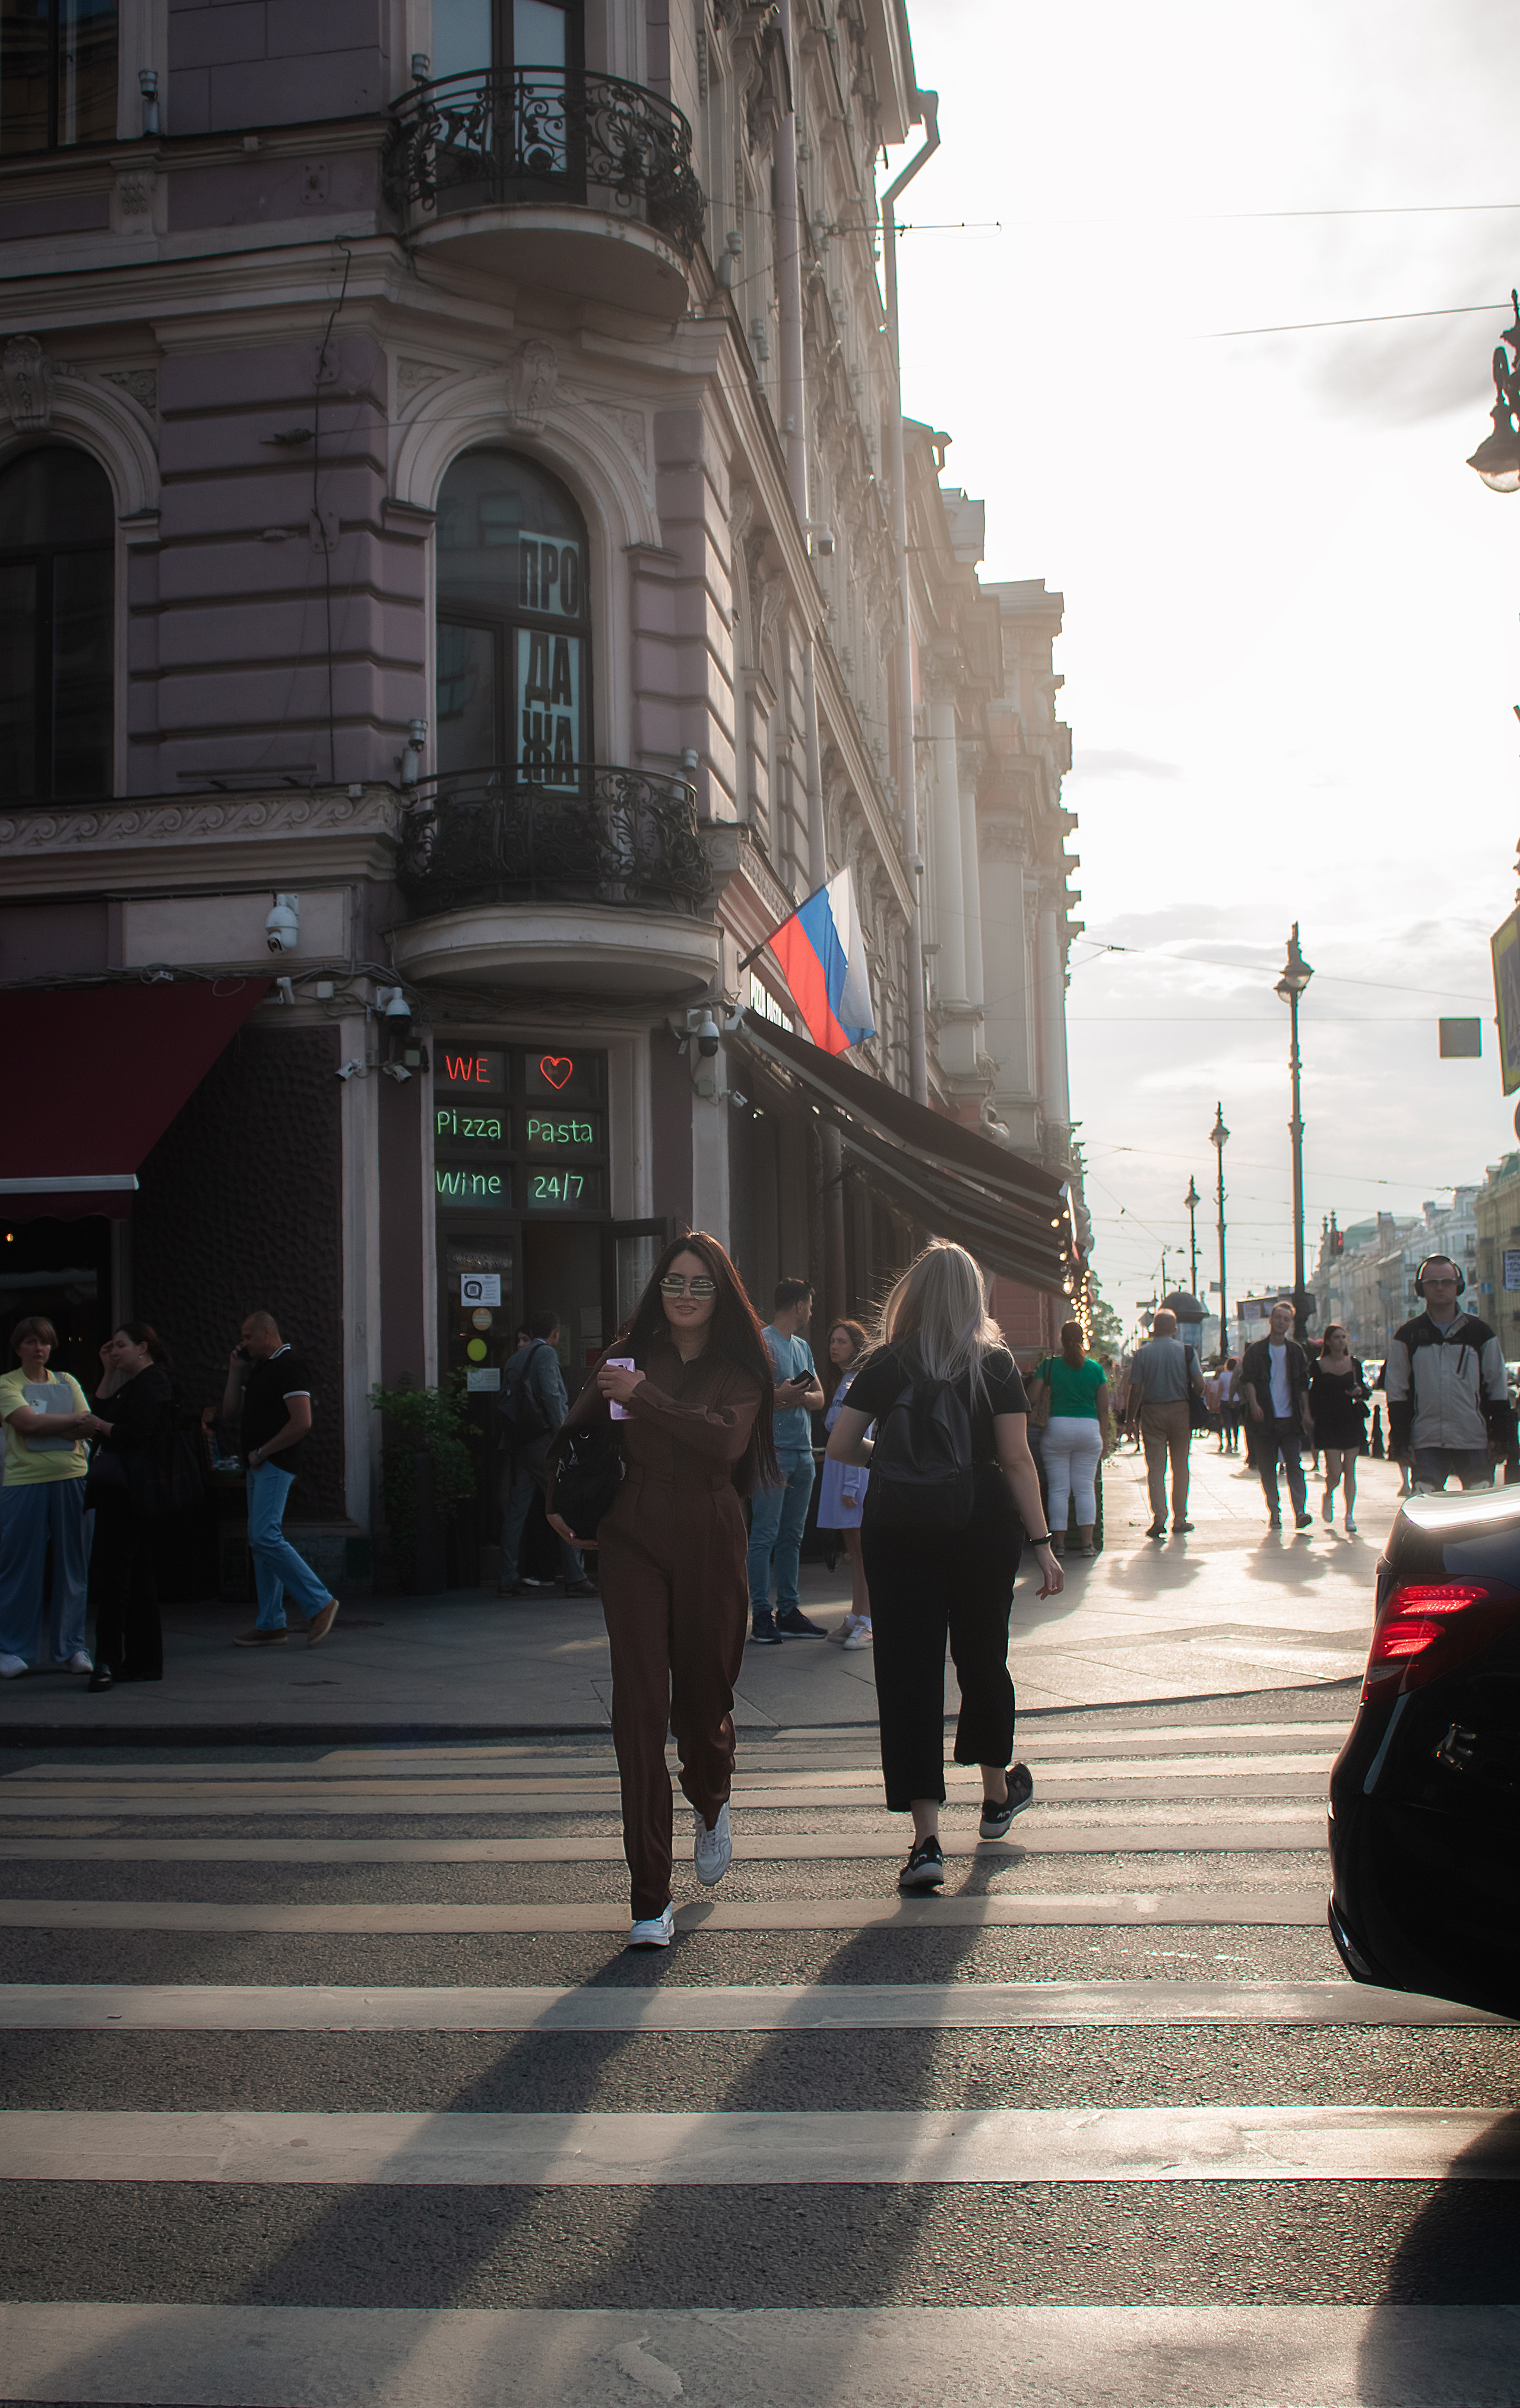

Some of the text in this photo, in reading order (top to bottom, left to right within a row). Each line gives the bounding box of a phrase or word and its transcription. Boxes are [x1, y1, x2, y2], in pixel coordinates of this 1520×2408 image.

[518, 538, 578, 616] ПРО
[525, 631, 572, 711] ДА
[522, 710, 575, 785] ЖА
[446, 1055, 490, 1083] WE
[437, 1109, 593, 1143] Pizza Pasta
[436, 1170, 584, 1201] Wine 24/7
